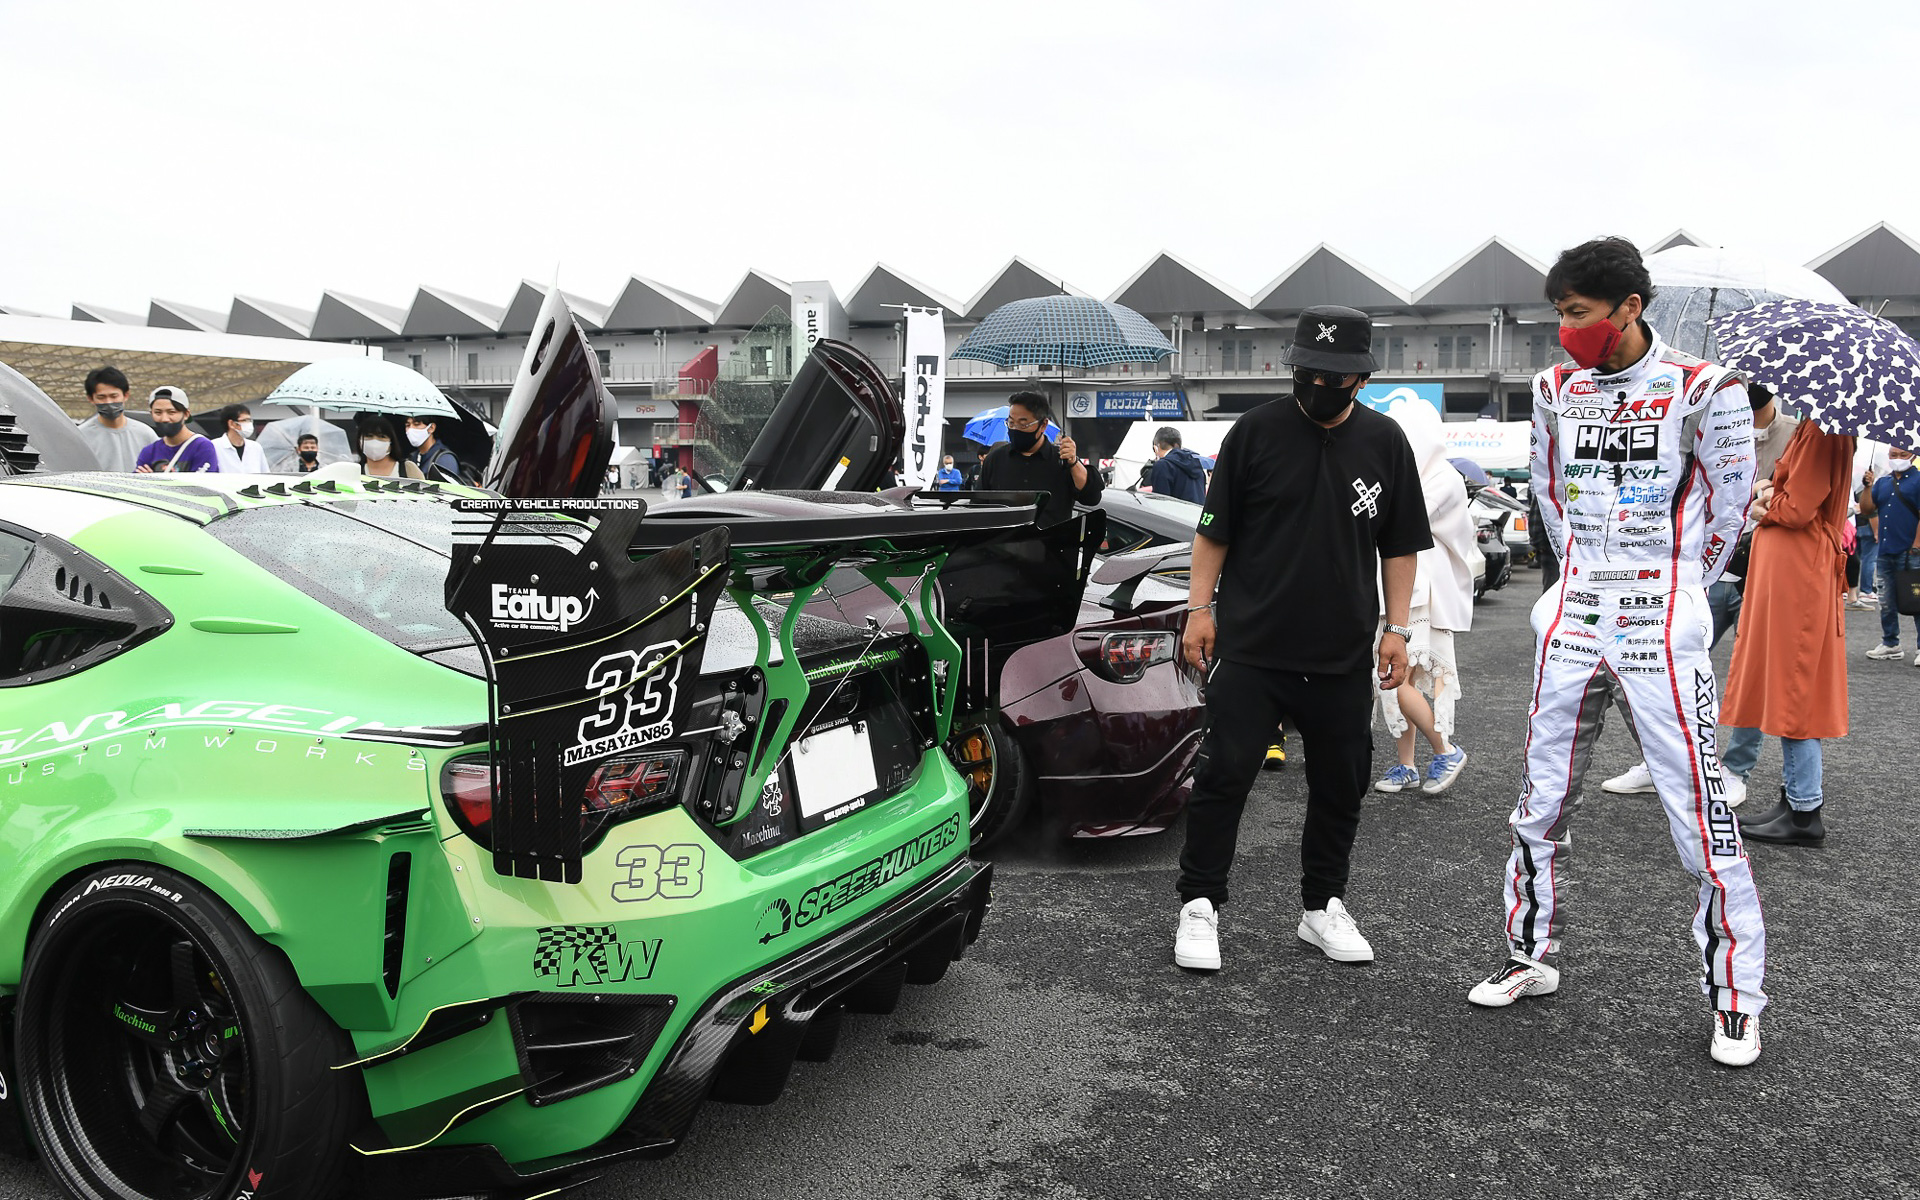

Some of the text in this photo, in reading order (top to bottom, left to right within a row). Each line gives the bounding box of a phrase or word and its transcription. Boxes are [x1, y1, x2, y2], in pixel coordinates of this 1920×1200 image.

[807, 310, 818, 343] auto
[1572, 382, 1597, 393] TONE
[1651, 381, 1672, 389] KIMIE
[636, 406, 656, 414] DyDo
[1561, 406, 1664, 422] ADVAN
[1446, 440, 1502, 448] OBELCO
[1574, 424, 1660, 462] HKS
[1723, 471, 1743, 484] SPK
[460, 500, 639, 510] CREATIVE VEHICLE PRODUCTIONS
[1632, 510, 1665, 518] FUJIMAKI
[1565, 597, 1600, 607] BRAKES
[1574, 591, 1600, 600] ACRE
[1619, 596, 1664, 606] CRS
[491, 583, 583, 632] Eatup
[1629, 619, 1665, 627] MODELS
[1564, 643, 1599, 656] CABANA
[1562, 658, 1595, 667] EDIFICE
[578, 640, 684, 742] 33
[566, 723, 671, 764] MASAYAN86
[8, 734, 426, 784] USTOM WORKS
[1695, 668, 1738, 857] HIPERMAX
[742, 824, 781, 849] Macchina
[611, 843, 705, 903] 33
[795, 811, 960, 927] SPEEDHUNTERS
[49, 894, 81, 927] ADVAN
[82, 874, 154, 897] NEOVA
[171, 892, 183, 903] R
[556, 938, 663, 987] KW
[112, 1003, 157, 1033] Macchina
